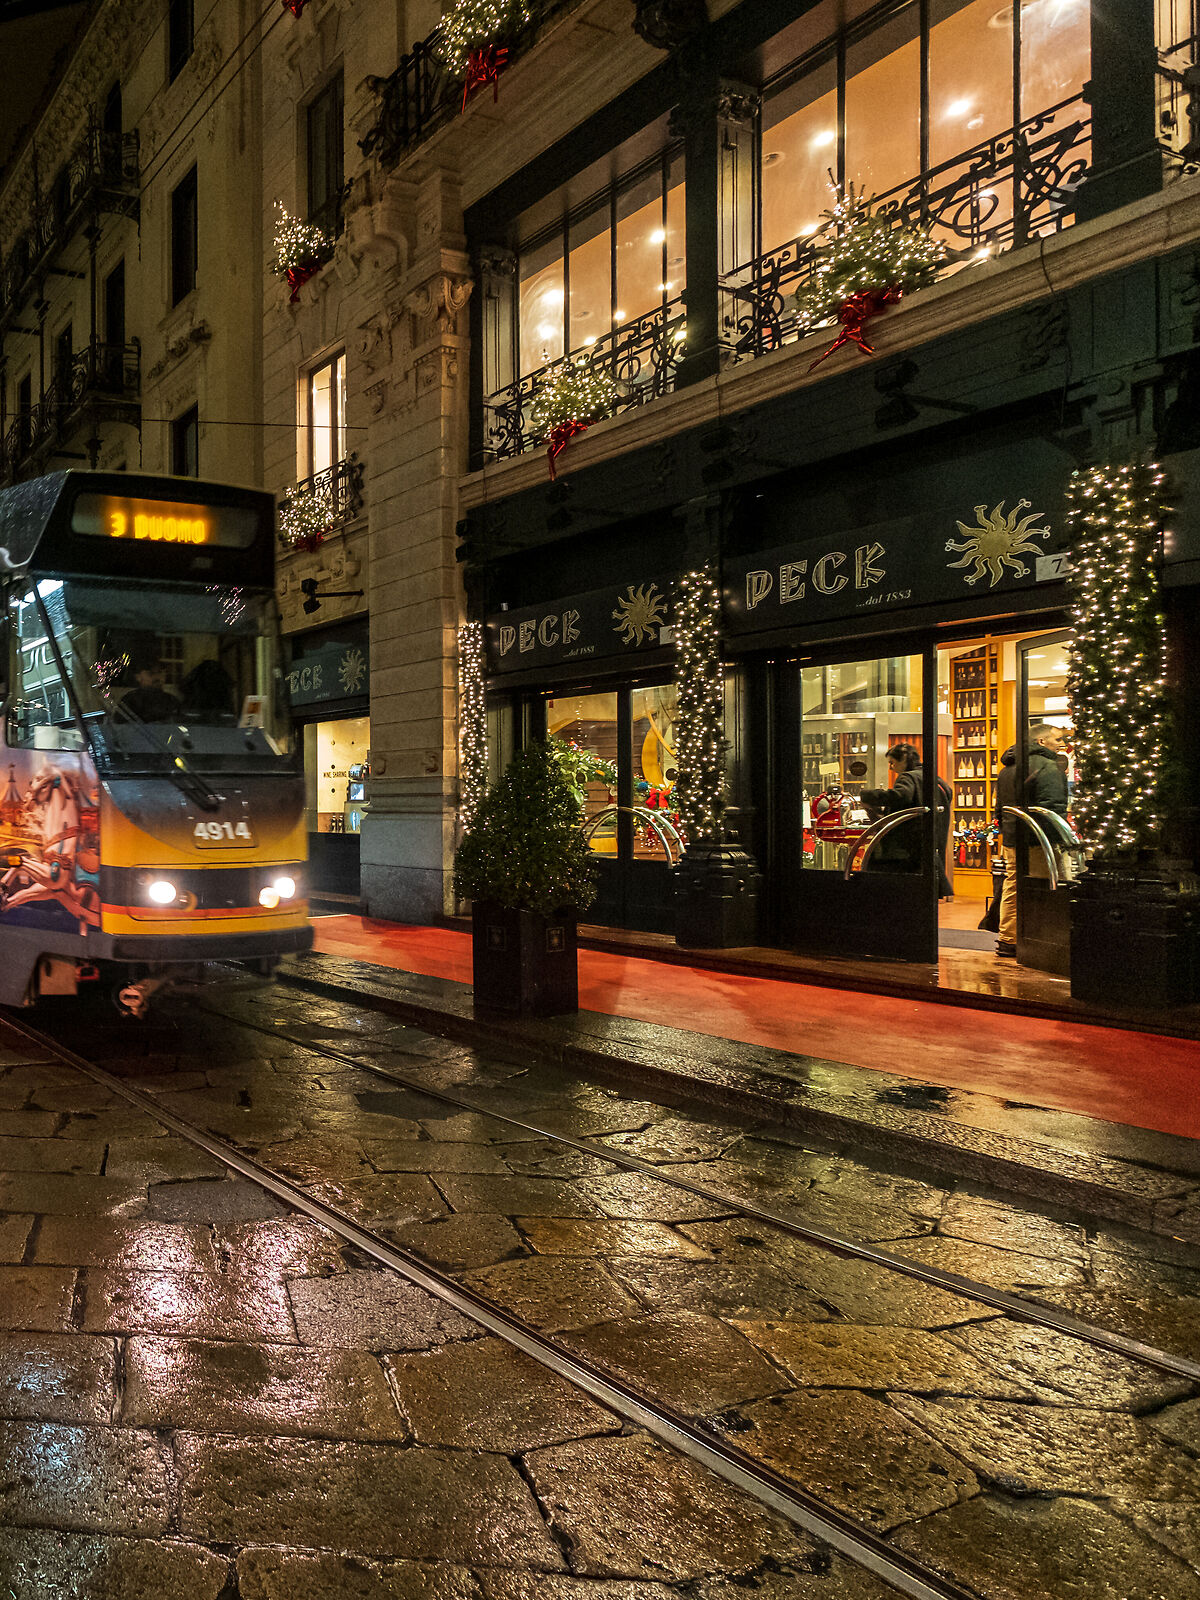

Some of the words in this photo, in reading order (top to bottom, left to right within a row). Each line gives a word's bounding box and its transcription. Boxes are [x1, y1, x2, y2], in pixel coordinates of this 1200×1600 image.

[110, 512, 125, 537] 3
[134, 514, 206, 544] DUOMO
[746, 541, 886, 611] PECK
[1051, 557, 1063, 574] 7
[885, 588, 912, 603] 1883
[499, 609, 581, 657] PECK
[194, 821, 252, 841] 4914
